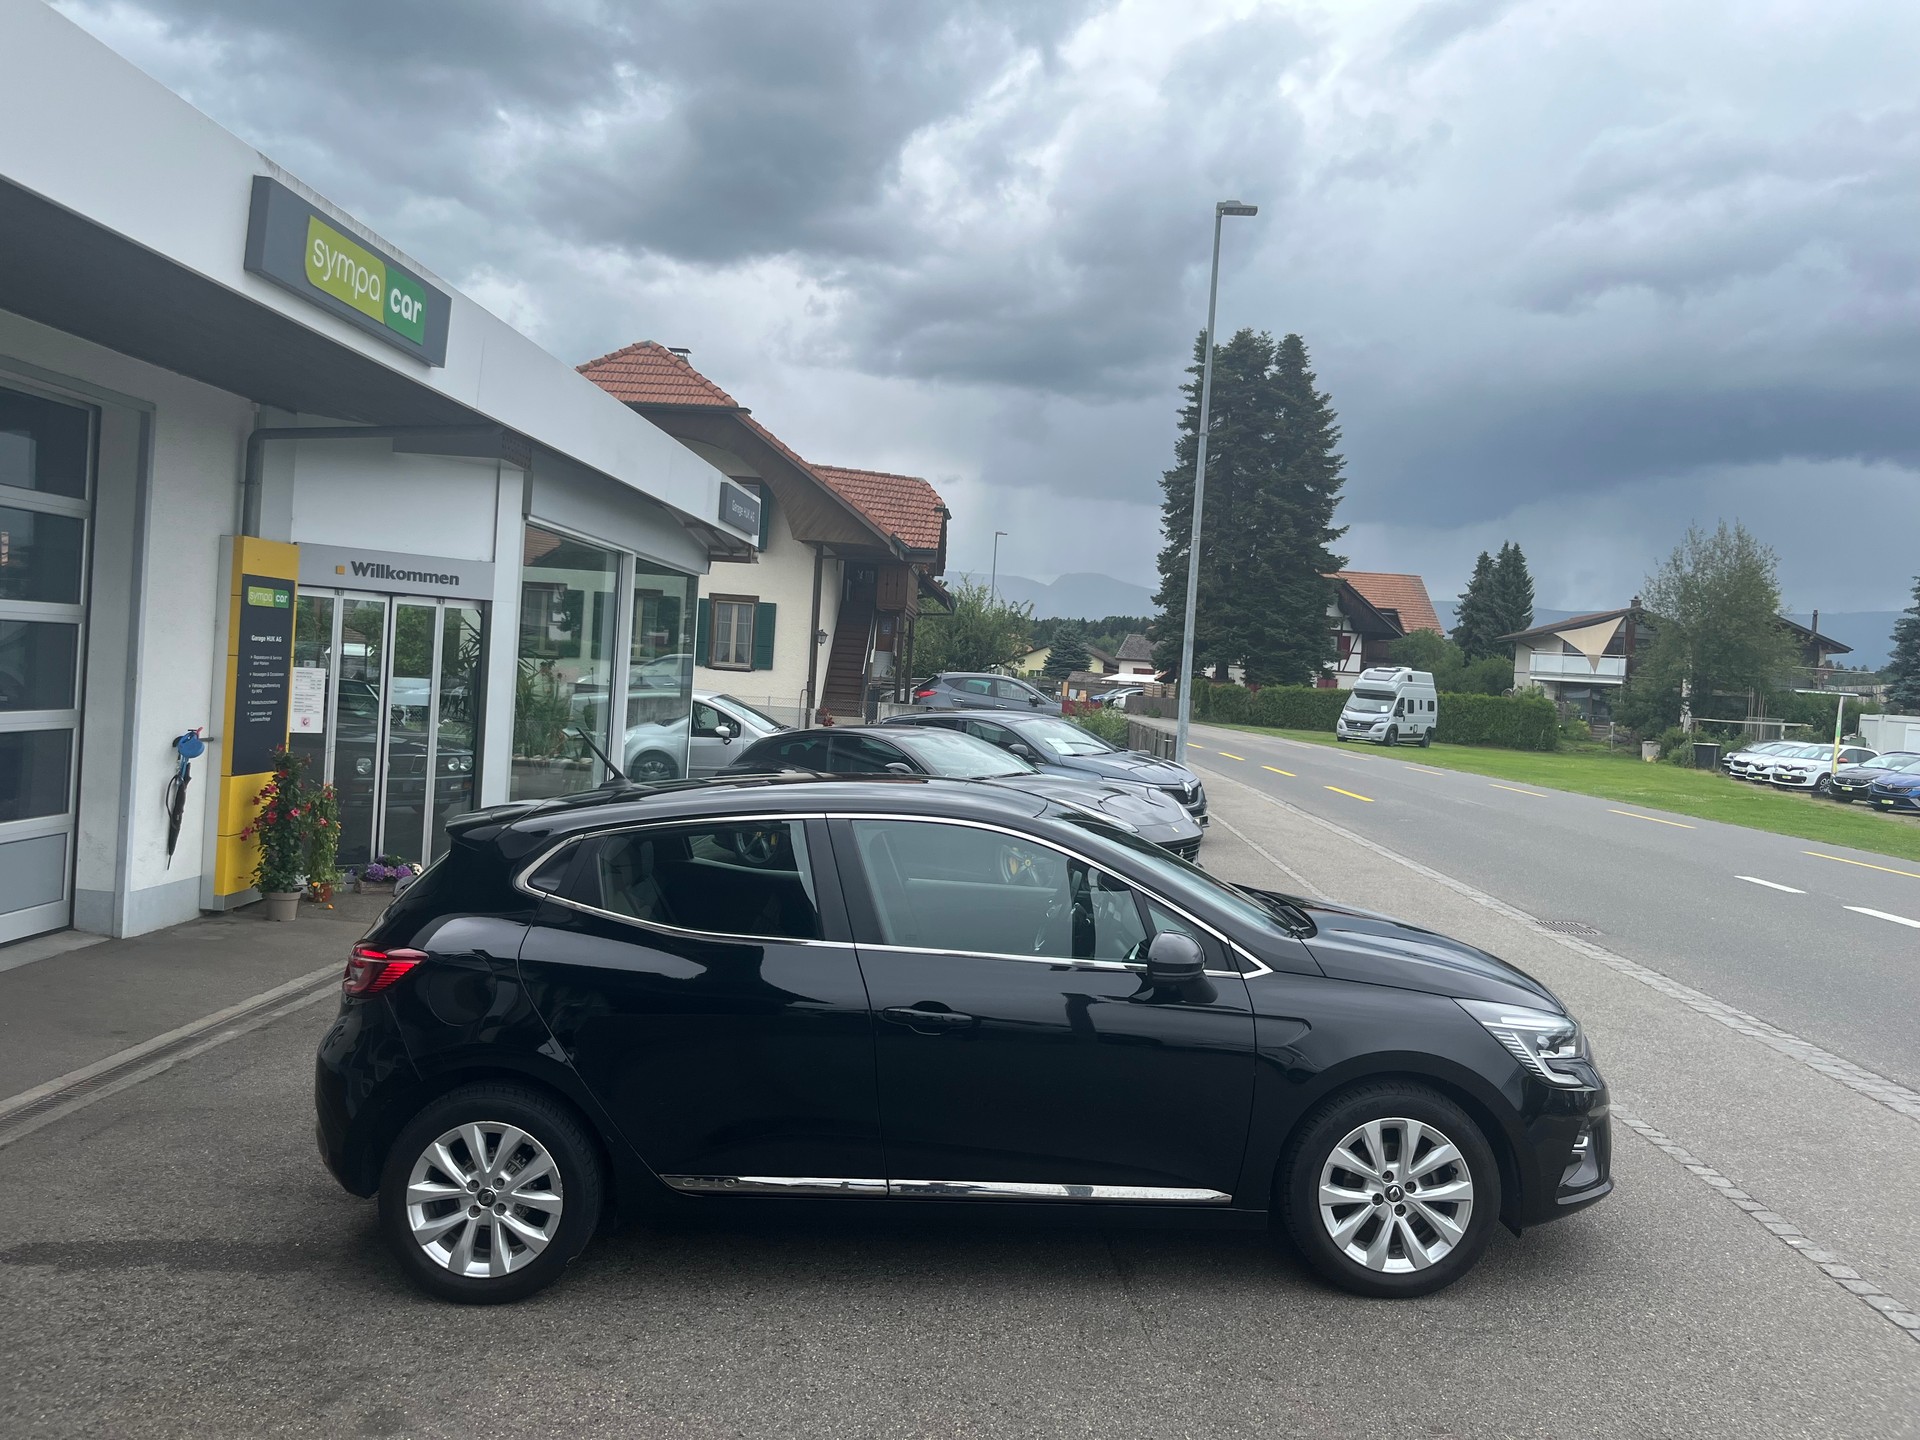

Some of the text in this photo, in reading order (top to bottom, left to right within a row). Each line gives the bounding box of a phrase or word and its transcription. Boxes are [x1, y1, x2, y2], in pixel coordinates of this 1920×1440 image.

[313, 238, 423, 324] sympa car
[351, 560, 459, 585] Willkommen
[248, 592, 288, 603] sympa car
[251, 634, 266, 643] Garage
[682, 1177, 735, 1187] CLIO
